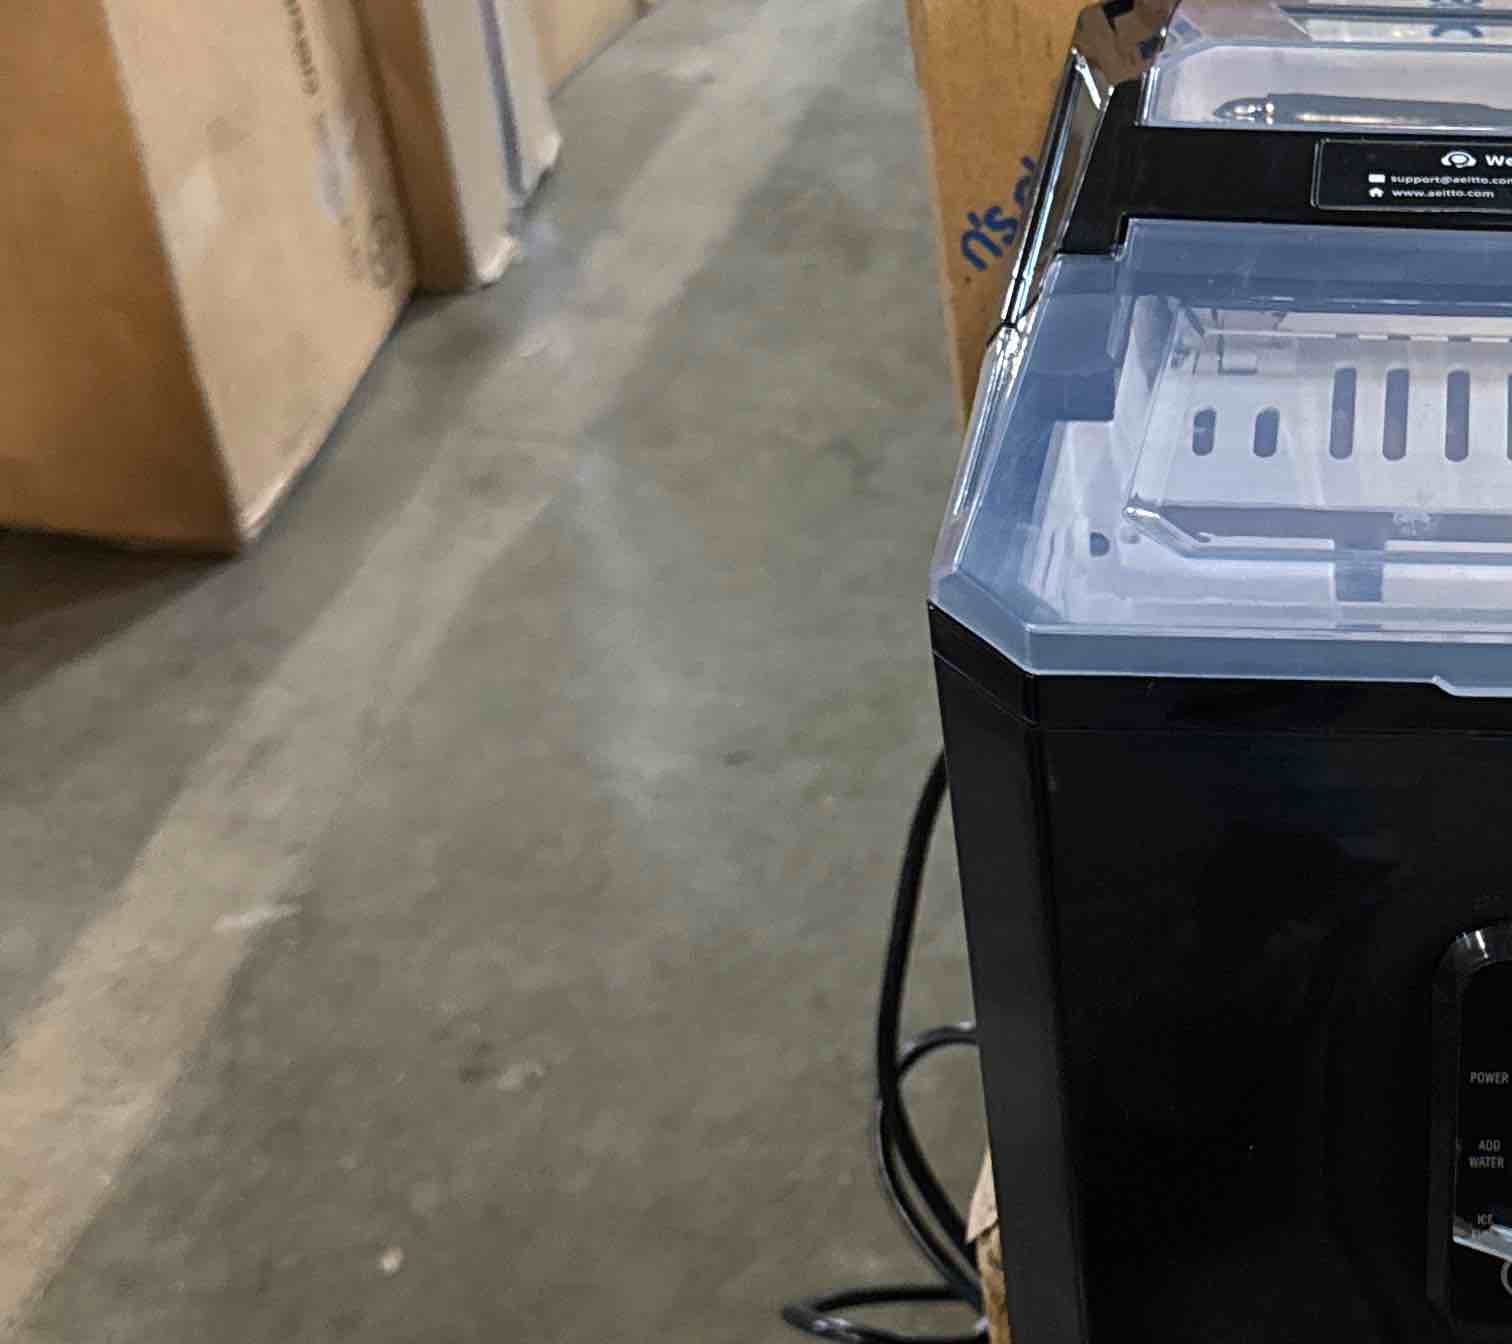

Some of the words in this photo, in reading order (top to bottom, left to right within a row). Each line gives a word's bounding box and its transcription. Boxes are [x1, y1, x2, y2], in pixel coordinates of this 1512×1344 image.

[1391, 188, 1496, 198] www.aeitto.com
[1469, 1071, 1509, 1085] POWER
[1479, 1139, 1501, 1152] ADD
[1469, 1156, 1504, 1169] WATER
